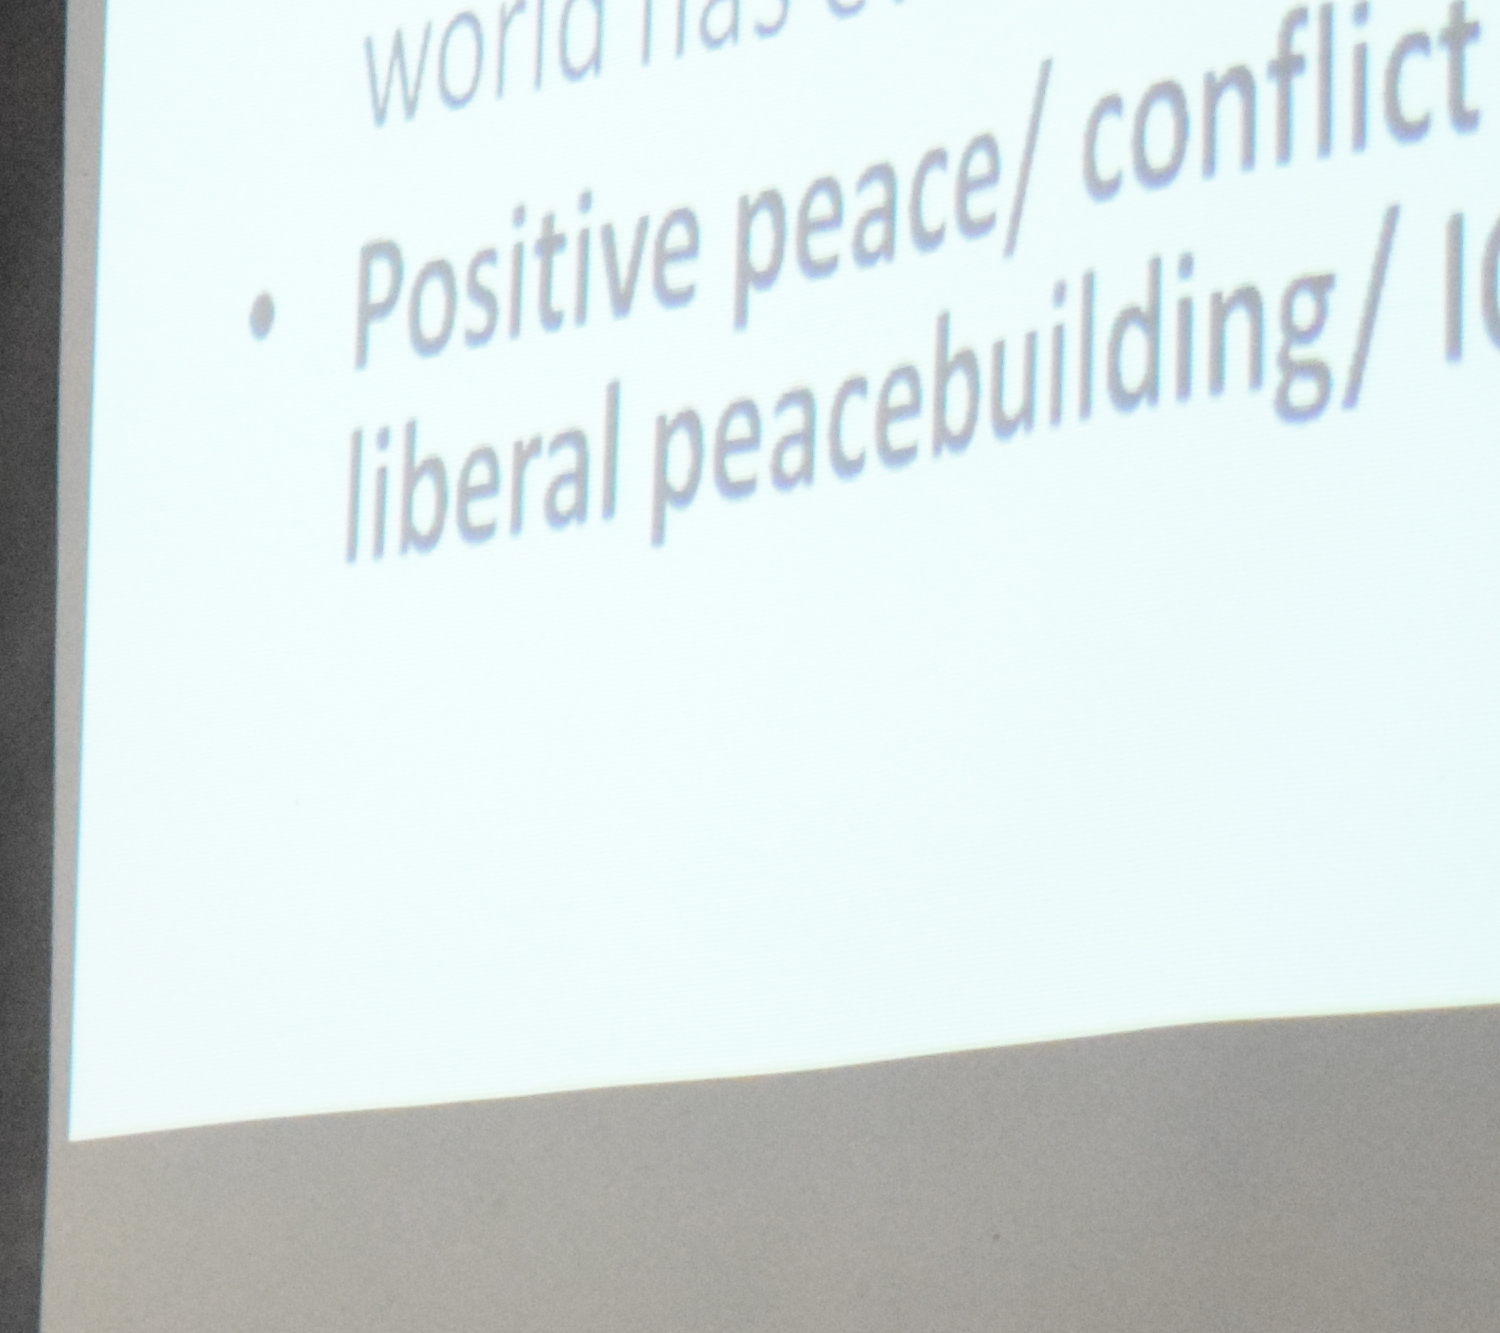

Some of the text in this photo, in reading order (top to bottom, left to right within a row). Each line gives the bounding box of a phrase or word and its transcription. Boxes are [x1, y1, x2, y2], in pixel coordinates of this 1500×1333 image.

[352, 0, 1484, 372] Positive peace/ conflict
[363, 0, 607, 128] world
[343, 201, 1500, 566] liberal peacebuilding/ I
